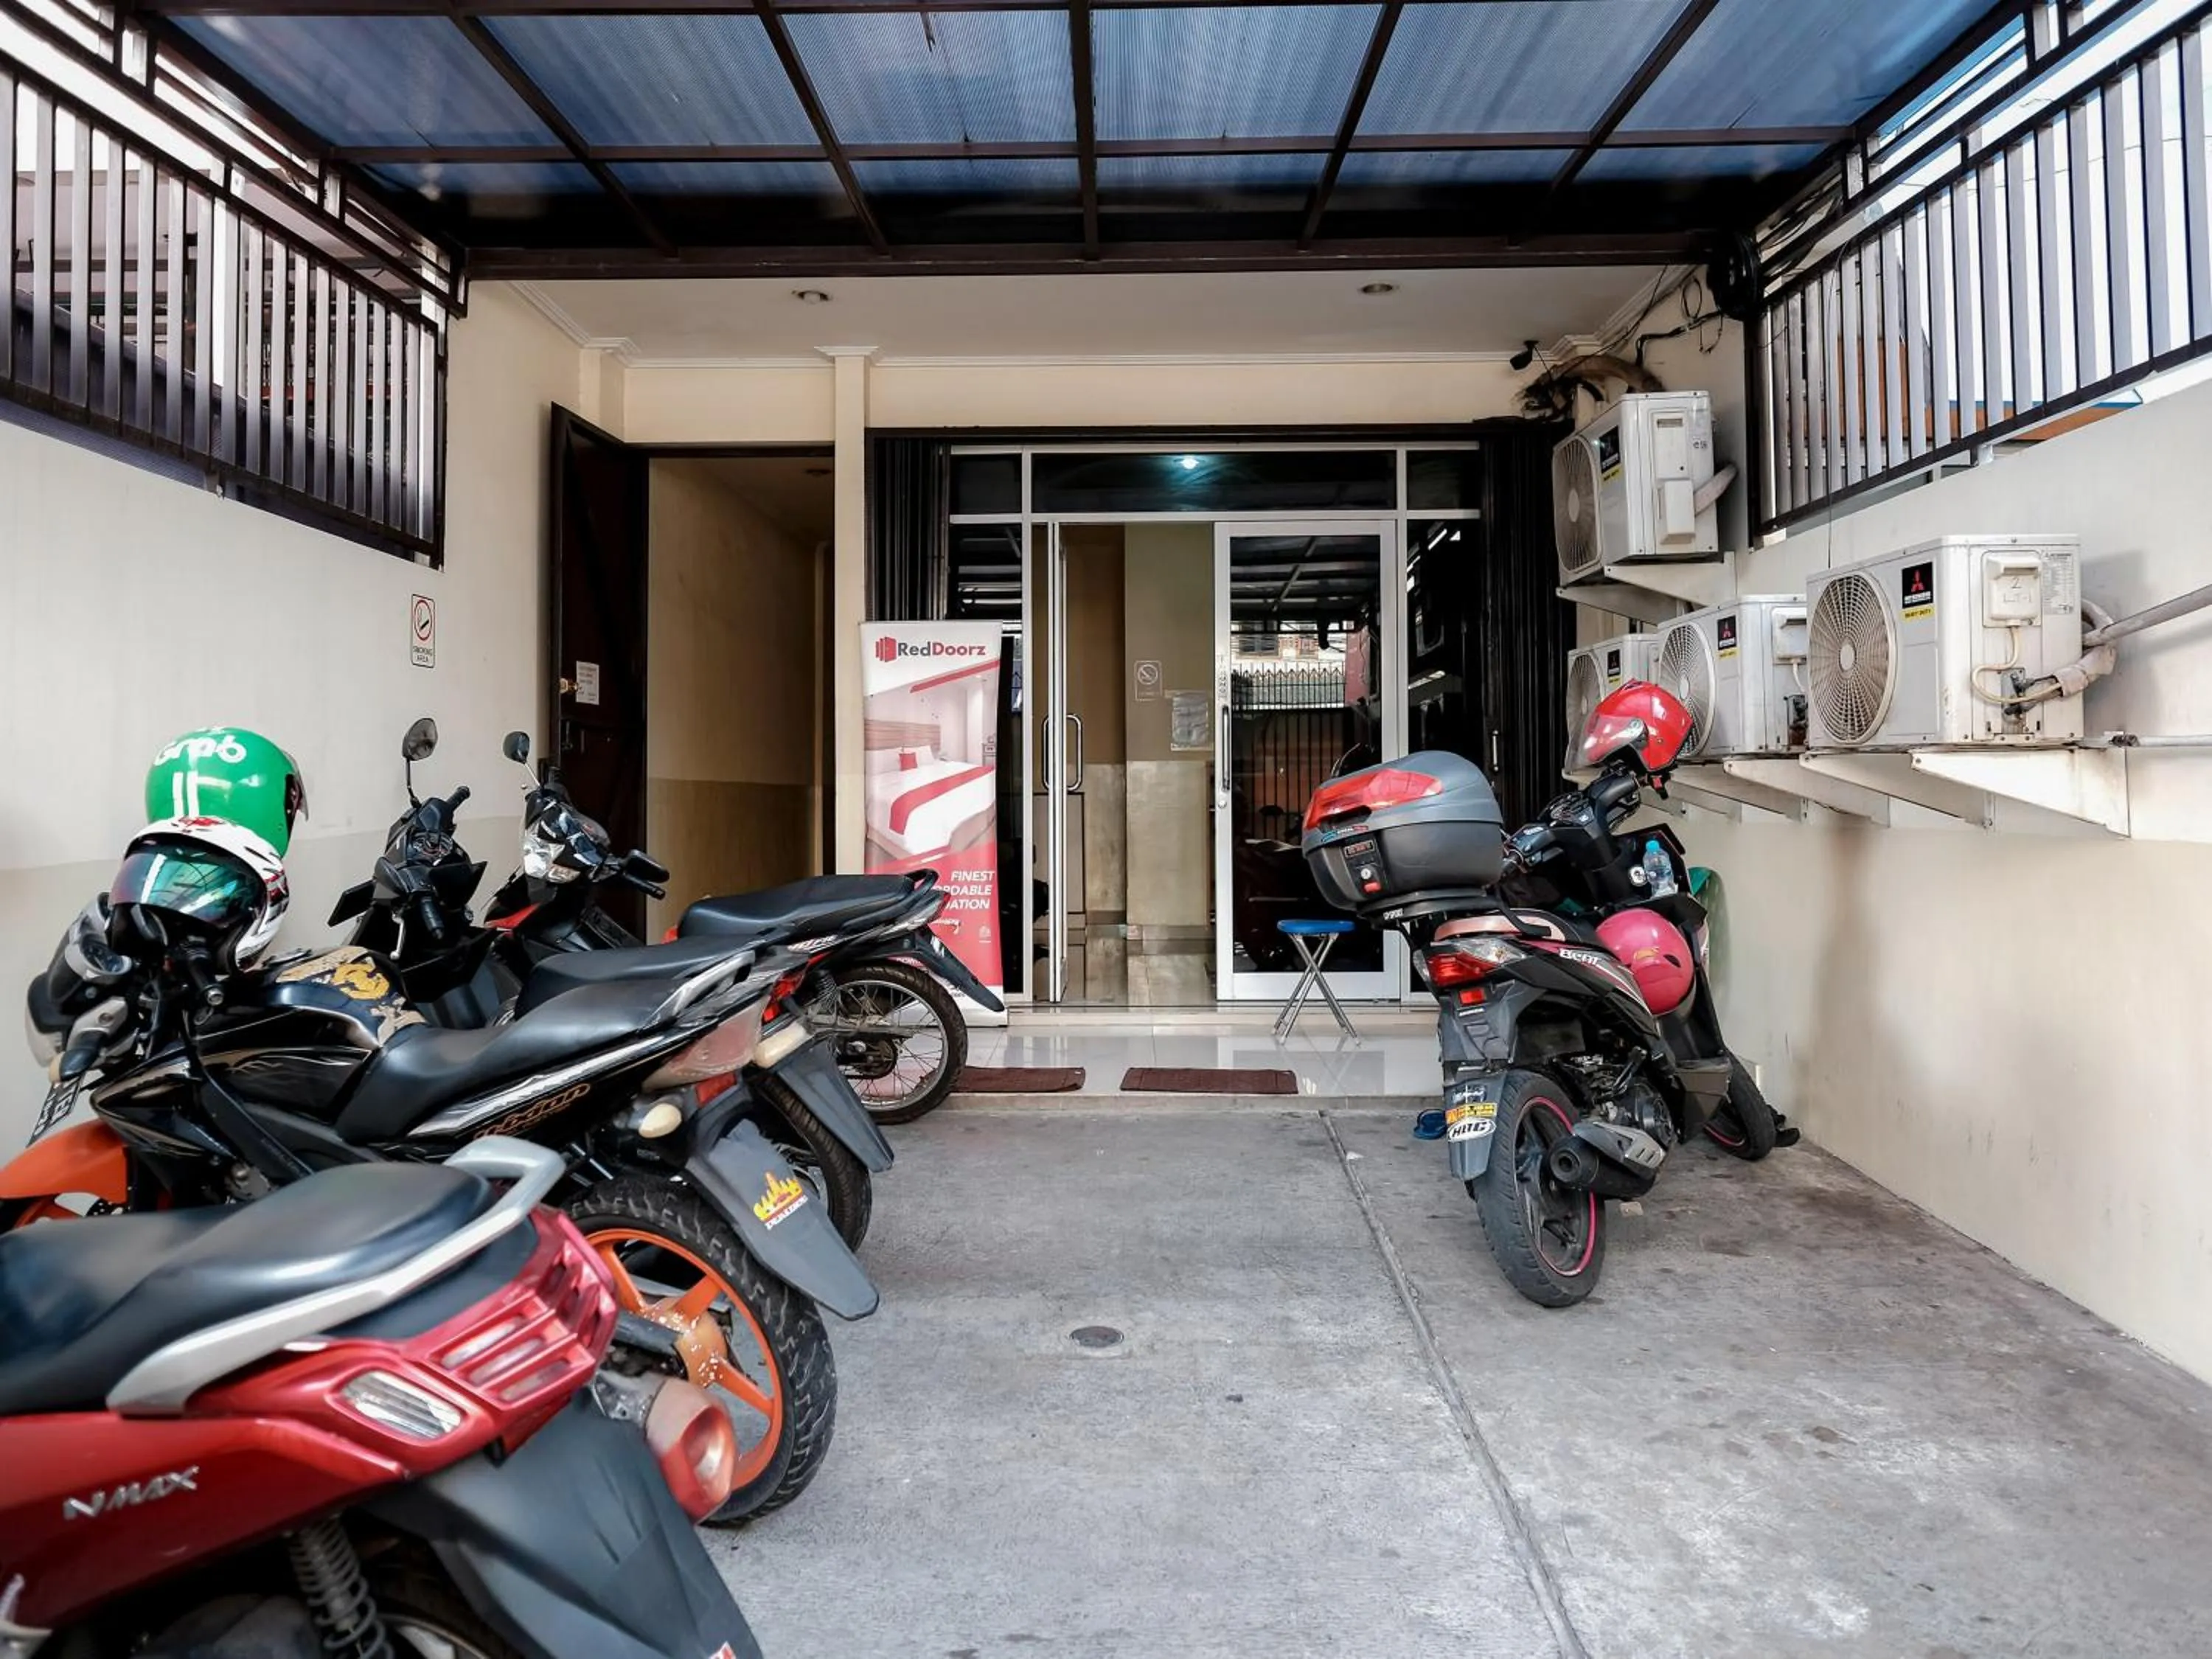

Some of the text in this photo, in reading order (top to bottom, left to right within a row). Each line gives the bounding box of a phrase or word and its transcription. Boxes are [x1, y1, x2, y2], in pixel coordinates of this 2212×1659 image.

[898, 641, 986, 657] RedDoorz
[950, 871, 995, 881] FINEST
[62, 1464, 200, 1520] NMAX
